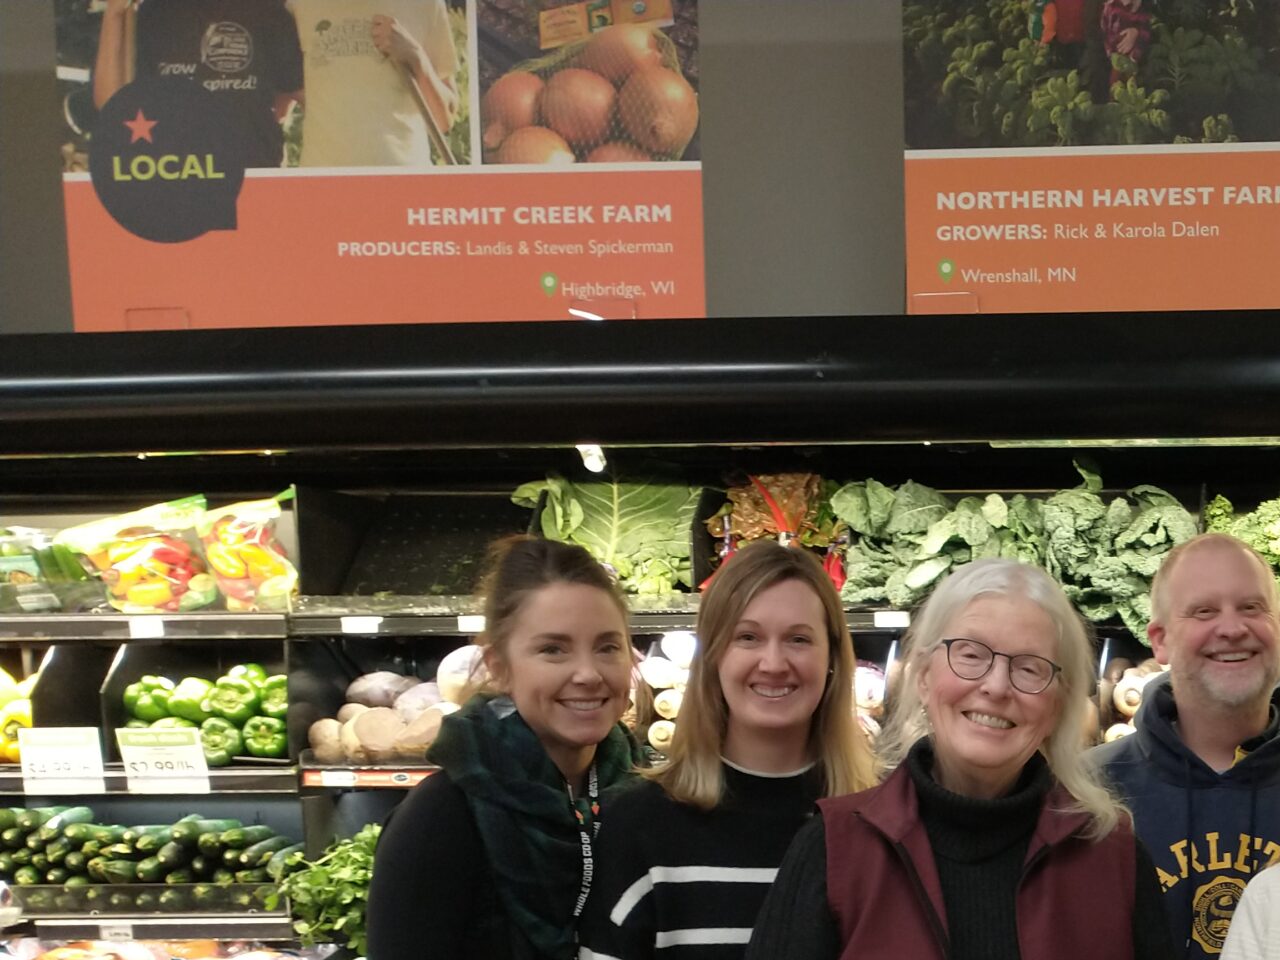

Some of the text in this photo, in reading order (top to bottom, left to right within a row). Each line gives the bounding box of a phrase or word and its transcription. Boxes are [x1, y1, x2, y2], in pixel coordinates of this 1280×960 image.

[112, 154, 225, 181] LOCAL
[936, 190, 1084, 210] NORTHERN
[1092, 188, 1215, 207] HARVEST
[406, 205, 672, 225] HERMIT CREEK FARM
[936, 221, 1219, 241] GROWERS: Rick & Karola Dalen
[338, 240, 674, 258] PRODUCERS: Landis & Steven Spickerman
[961, 267, 1076, 285] Wrenshall, MN
[561, 281, 675, 300] Highbridge, WI
[581, 857, 594, 887] FOODS
[573, 886, 591, 917] WHOLE
